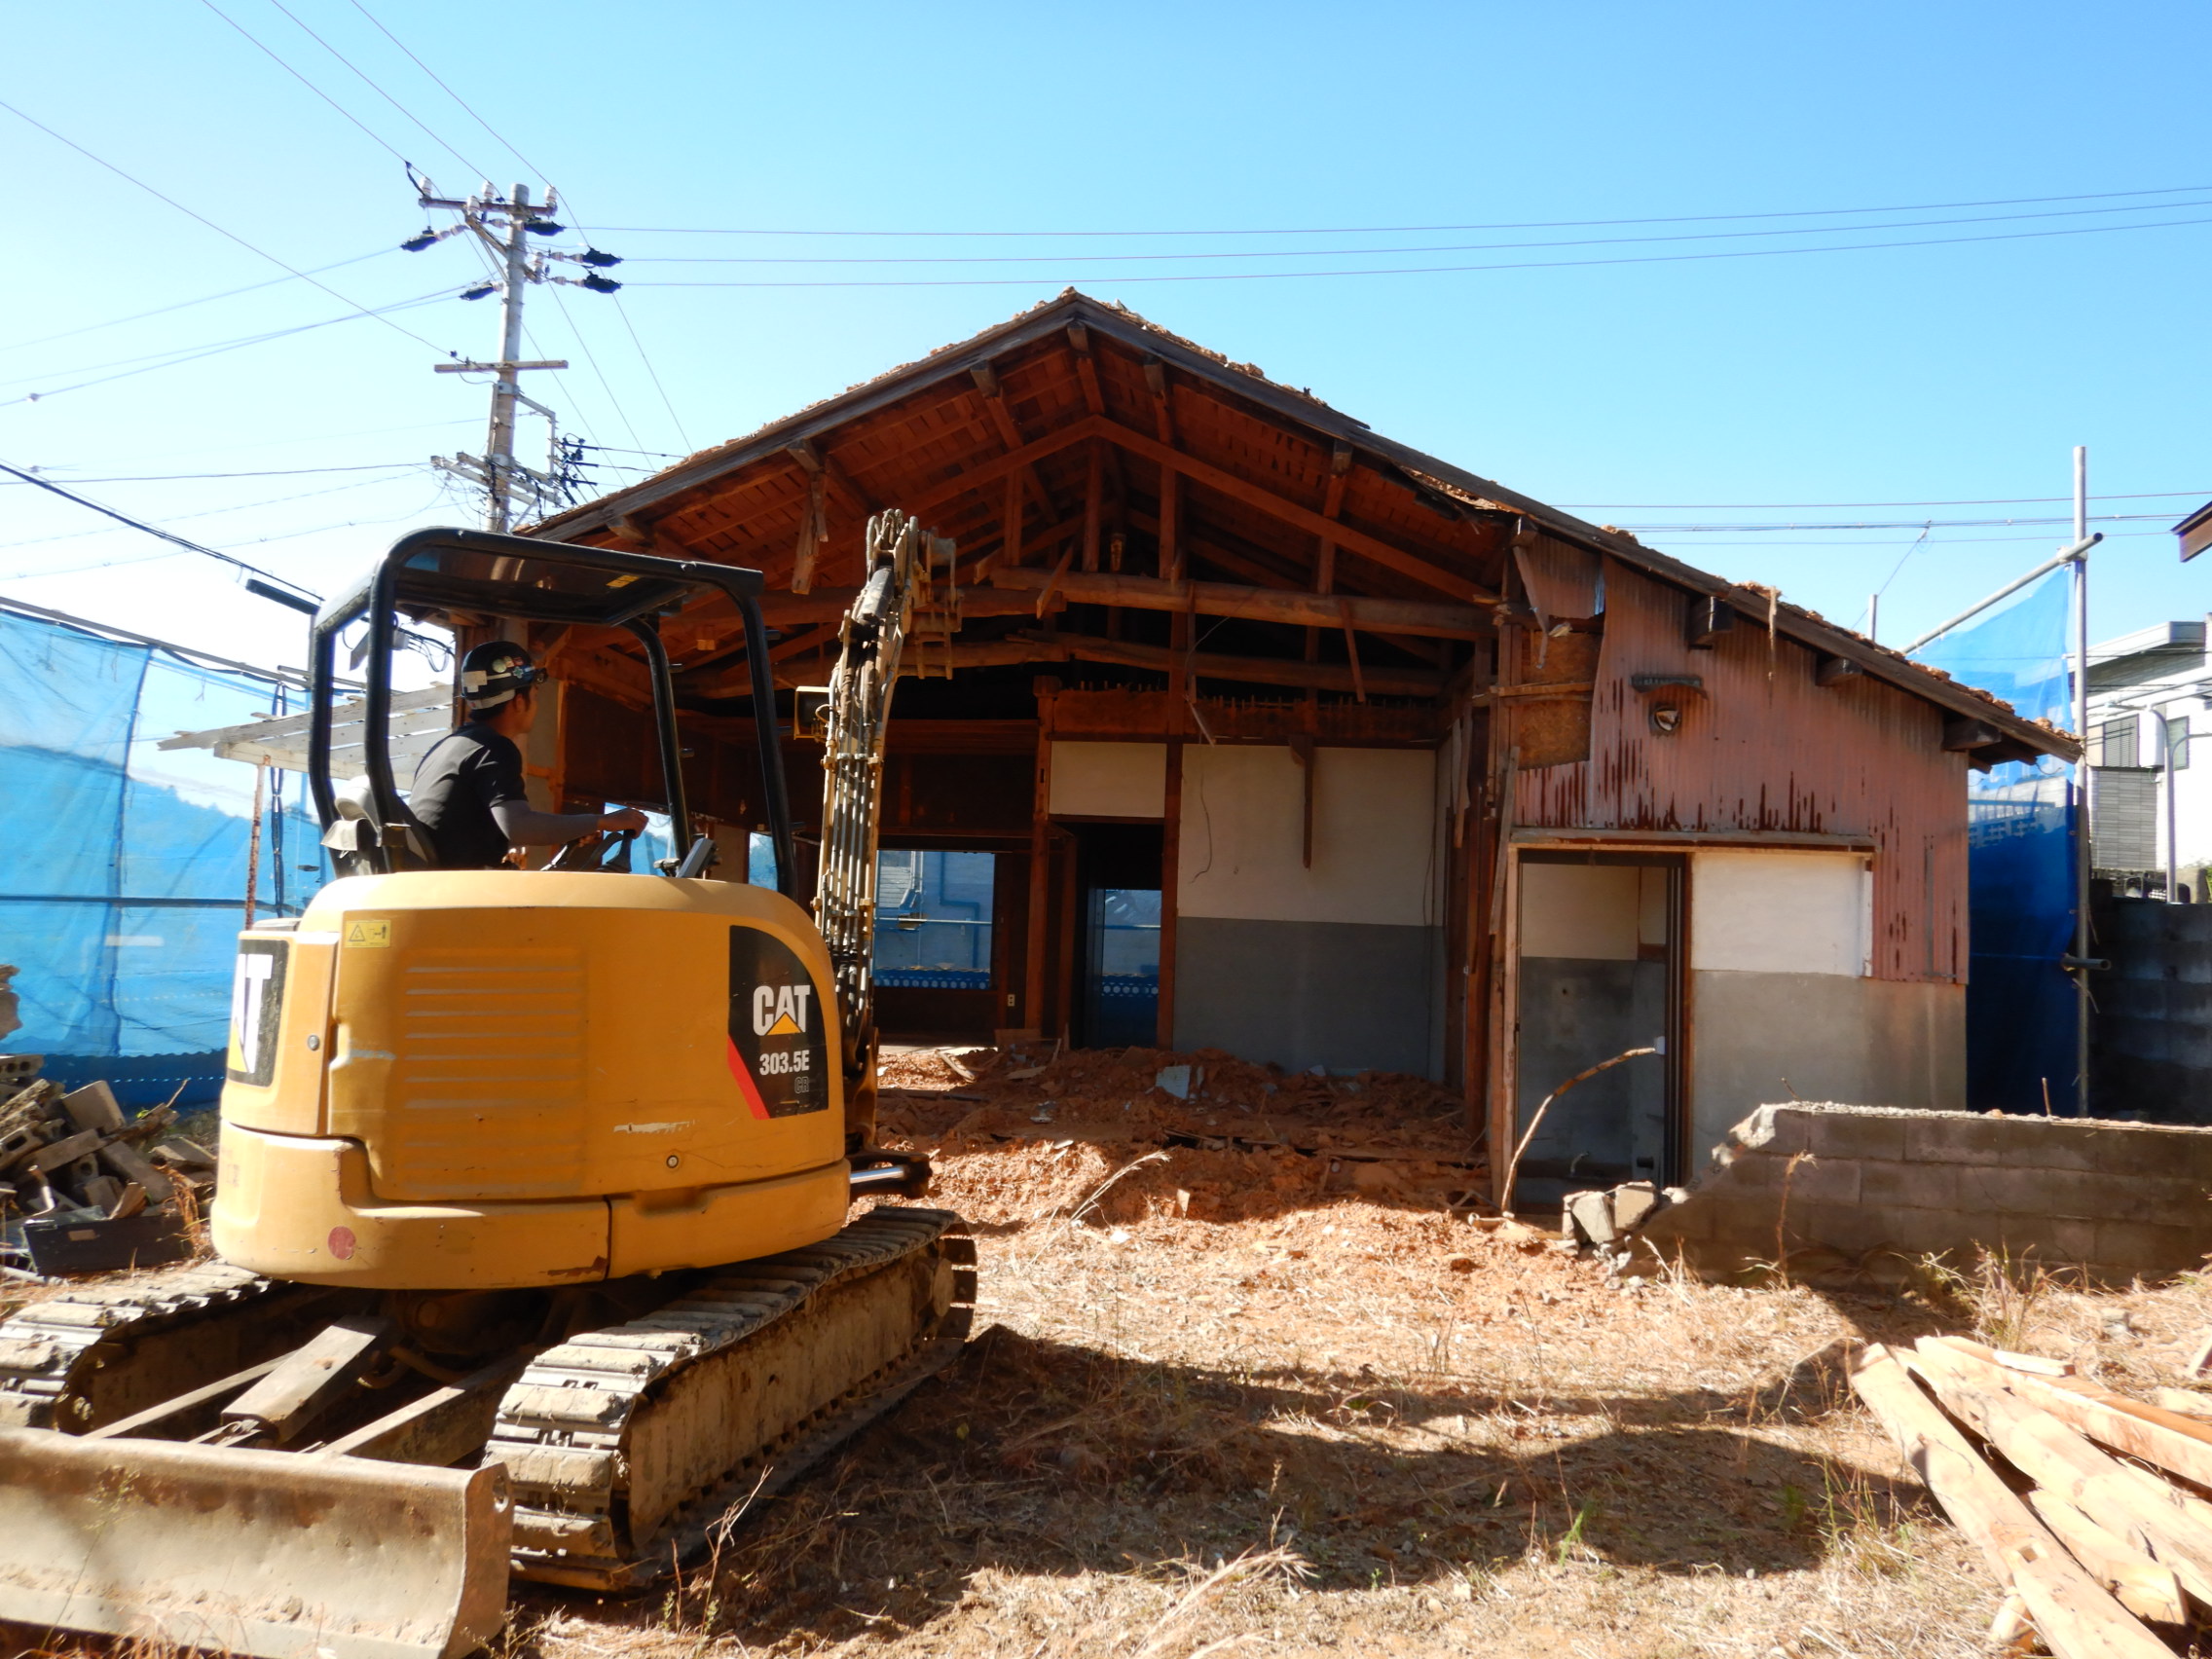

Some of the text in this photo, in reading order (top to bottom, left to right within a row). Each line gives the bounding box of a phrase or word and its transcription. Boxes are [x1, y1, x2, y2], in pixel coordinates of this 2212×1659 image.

[753, 984, 811, 1037] CAT
[758, 1050, 810, 1076] 303.5E
[793, 1076, 810, 1094] CR
